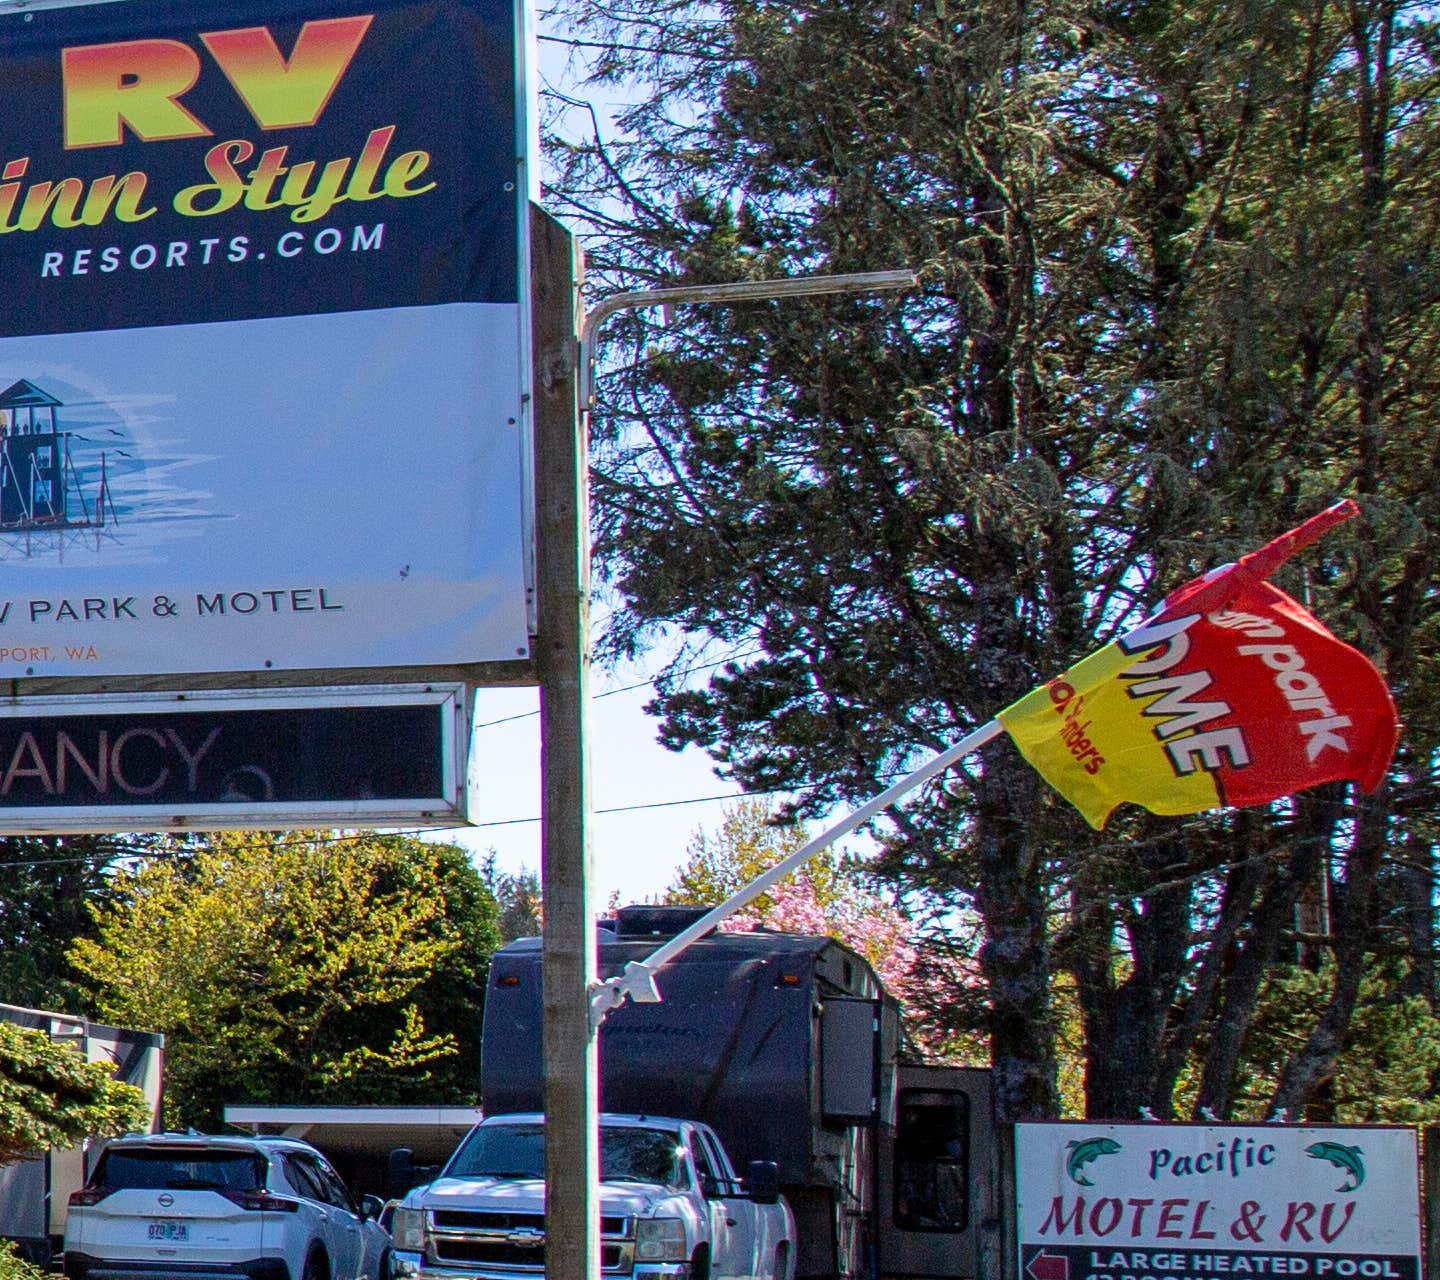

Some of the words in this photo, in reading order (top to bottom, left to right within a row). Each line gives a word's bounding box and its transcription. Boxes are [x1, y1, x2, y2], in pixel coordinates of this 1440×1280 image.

[61, 14, 375, 150] RV
[173, 125, 437, 223] Style
[41, 223, 385, 277] RESORTS.COM
[28, 596, 136, 623] PARK
[151, 595, 178, 617] &
[196, 588, 345, 616] MOTEL
[64, 645, 100, 662] WA
[1236, 643, 1353, 764] park
[1148, 1136, 1277, 1180] Pacific
[1037, 1194, 1217, 1241] MOTEL
[1229, 1200, 1268, 1244] &
[1280, 1200, 1357, 1244] RV
[1091, 1251, 1186, 1272] LARGE
[1193, 1254, 1309, 1275] HEATED
[1315, 1258, 1400, 1279] POOL
